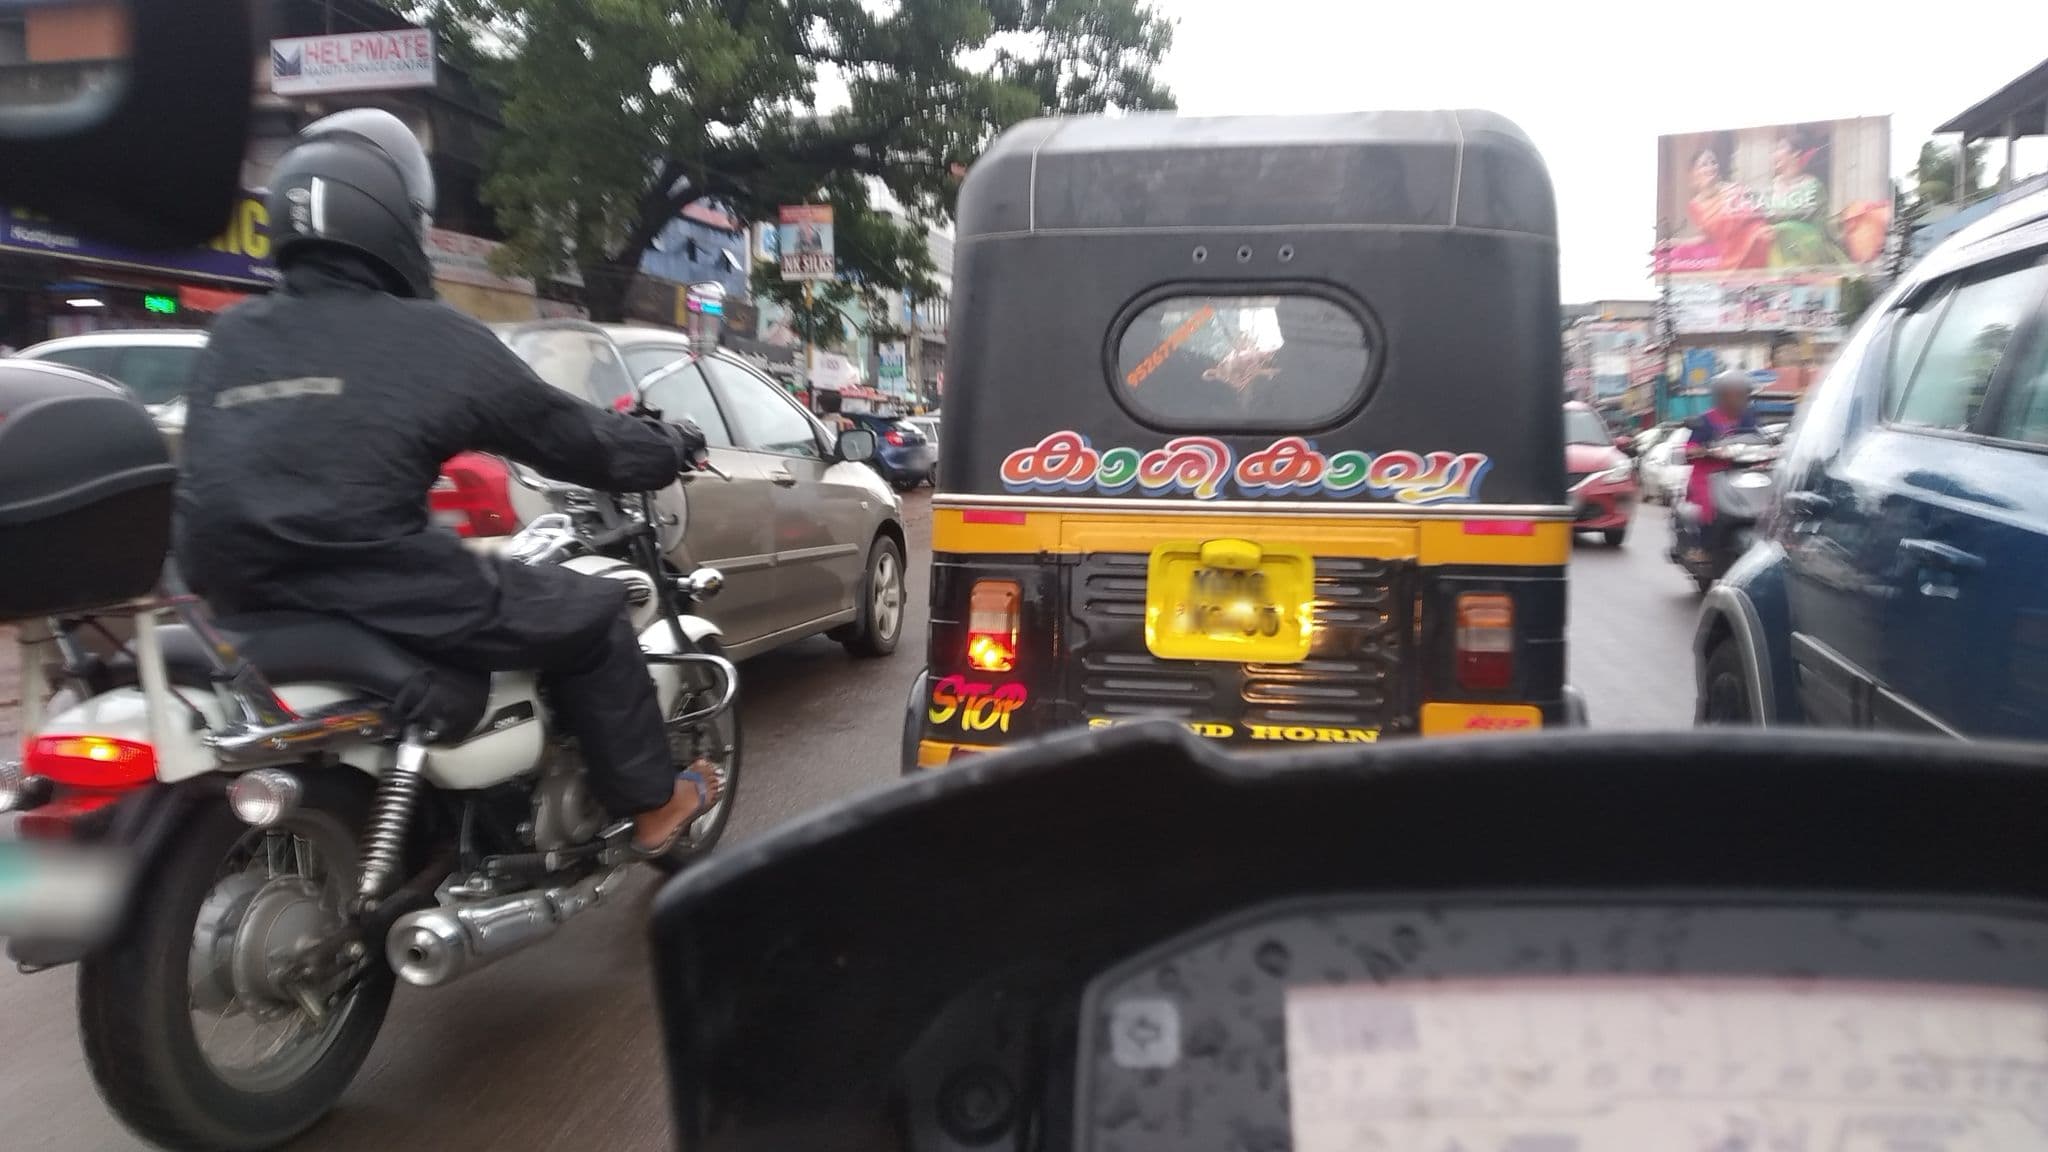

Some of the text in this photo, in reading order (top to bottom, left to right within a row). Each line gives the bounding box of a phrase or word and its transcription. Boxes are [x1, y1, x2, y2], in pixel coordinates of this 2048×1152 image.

[304, 34, 431, 64] HELPMATE
[928, 674, 1028, 733] STOP
[1250, 724, 1380, 744] HORN
